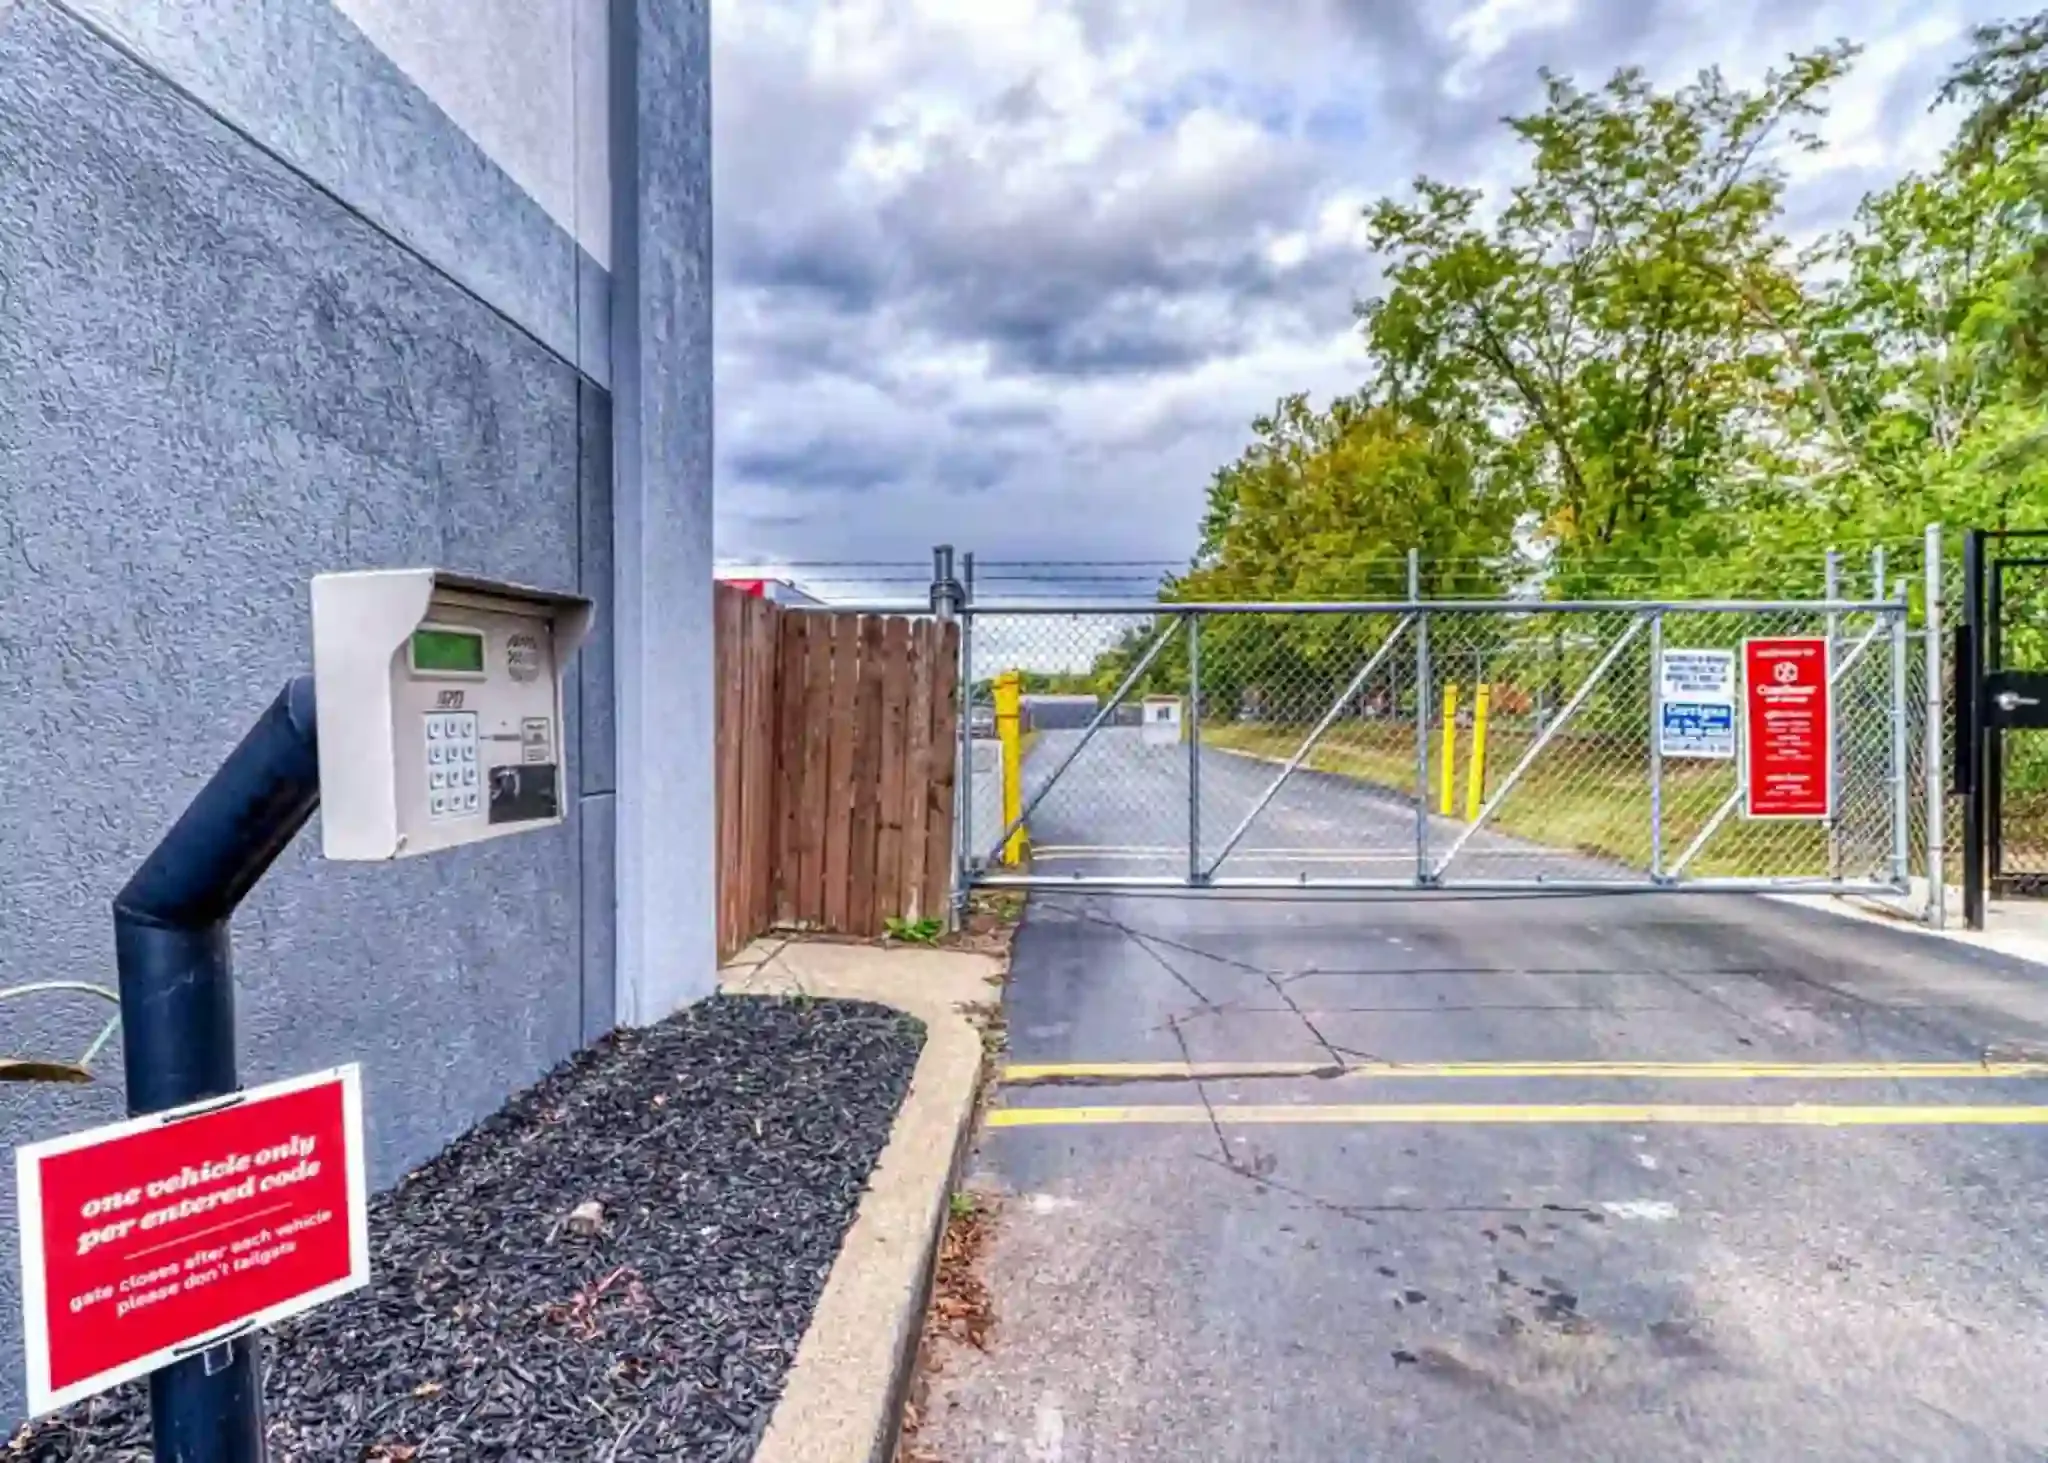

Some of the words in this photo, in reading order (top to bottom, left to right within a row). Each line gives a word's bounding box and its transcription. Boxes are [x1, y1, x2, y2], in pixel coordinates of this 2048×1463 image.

[76, 1218, 137, 1255] per
[140, 1176, 256, 1230] entered
[260, 1160, 321, 1191] code
[81, 1187, 142, 1218] one
[146, 1152, 252, 1198] vehicle
[254, 1135, 316, 1165] only
[69, 1285, 114, 1313] gate
[119, 1262, 180, 1292] closes
[184, 1246, 228, 1270] after
[231, 1228, 272, 1253] each
[275, 1209, 333, 1236] vehicle
[116, 1282, 180, 1319] please
[233, 1241, 297, 1273] tailgate
